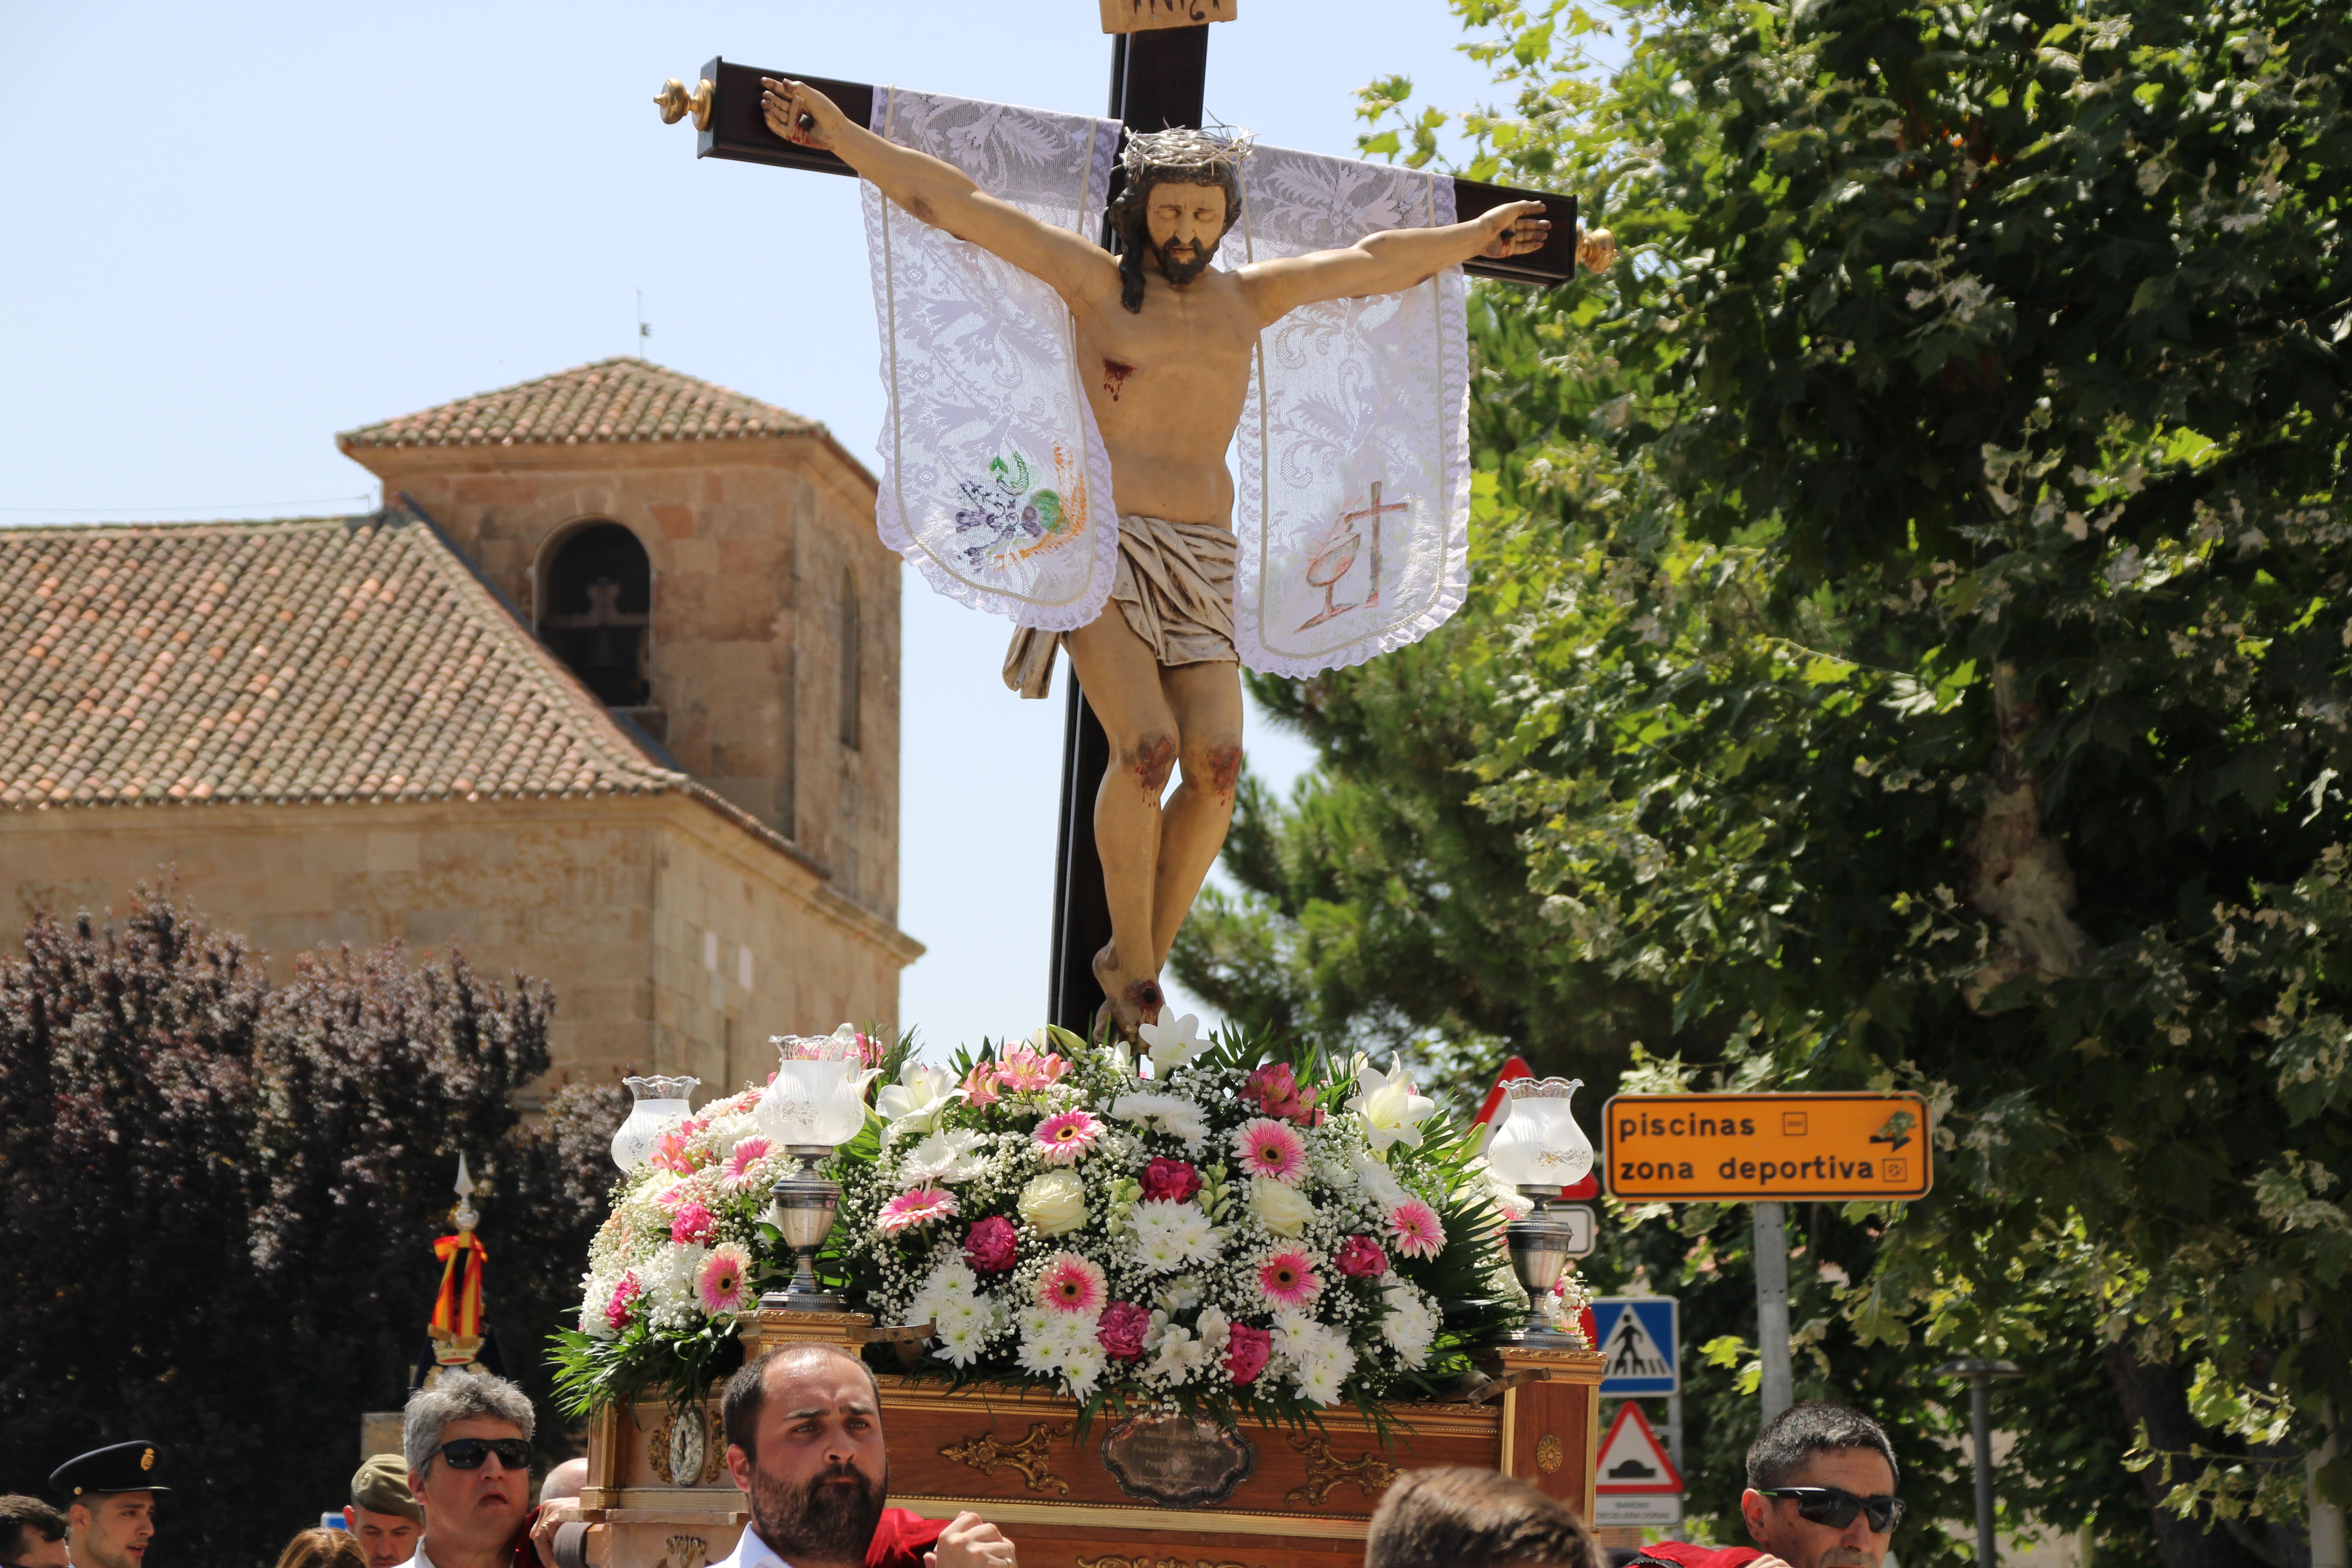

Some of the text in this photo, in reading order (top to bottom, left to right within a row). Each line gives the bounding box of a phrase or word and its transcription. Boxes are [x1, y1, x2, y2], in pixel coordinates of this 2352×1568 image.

[1620, 1112, 1755, 1142] piscinas
[1621, 1155, 1874, 1185] zona deportiva
